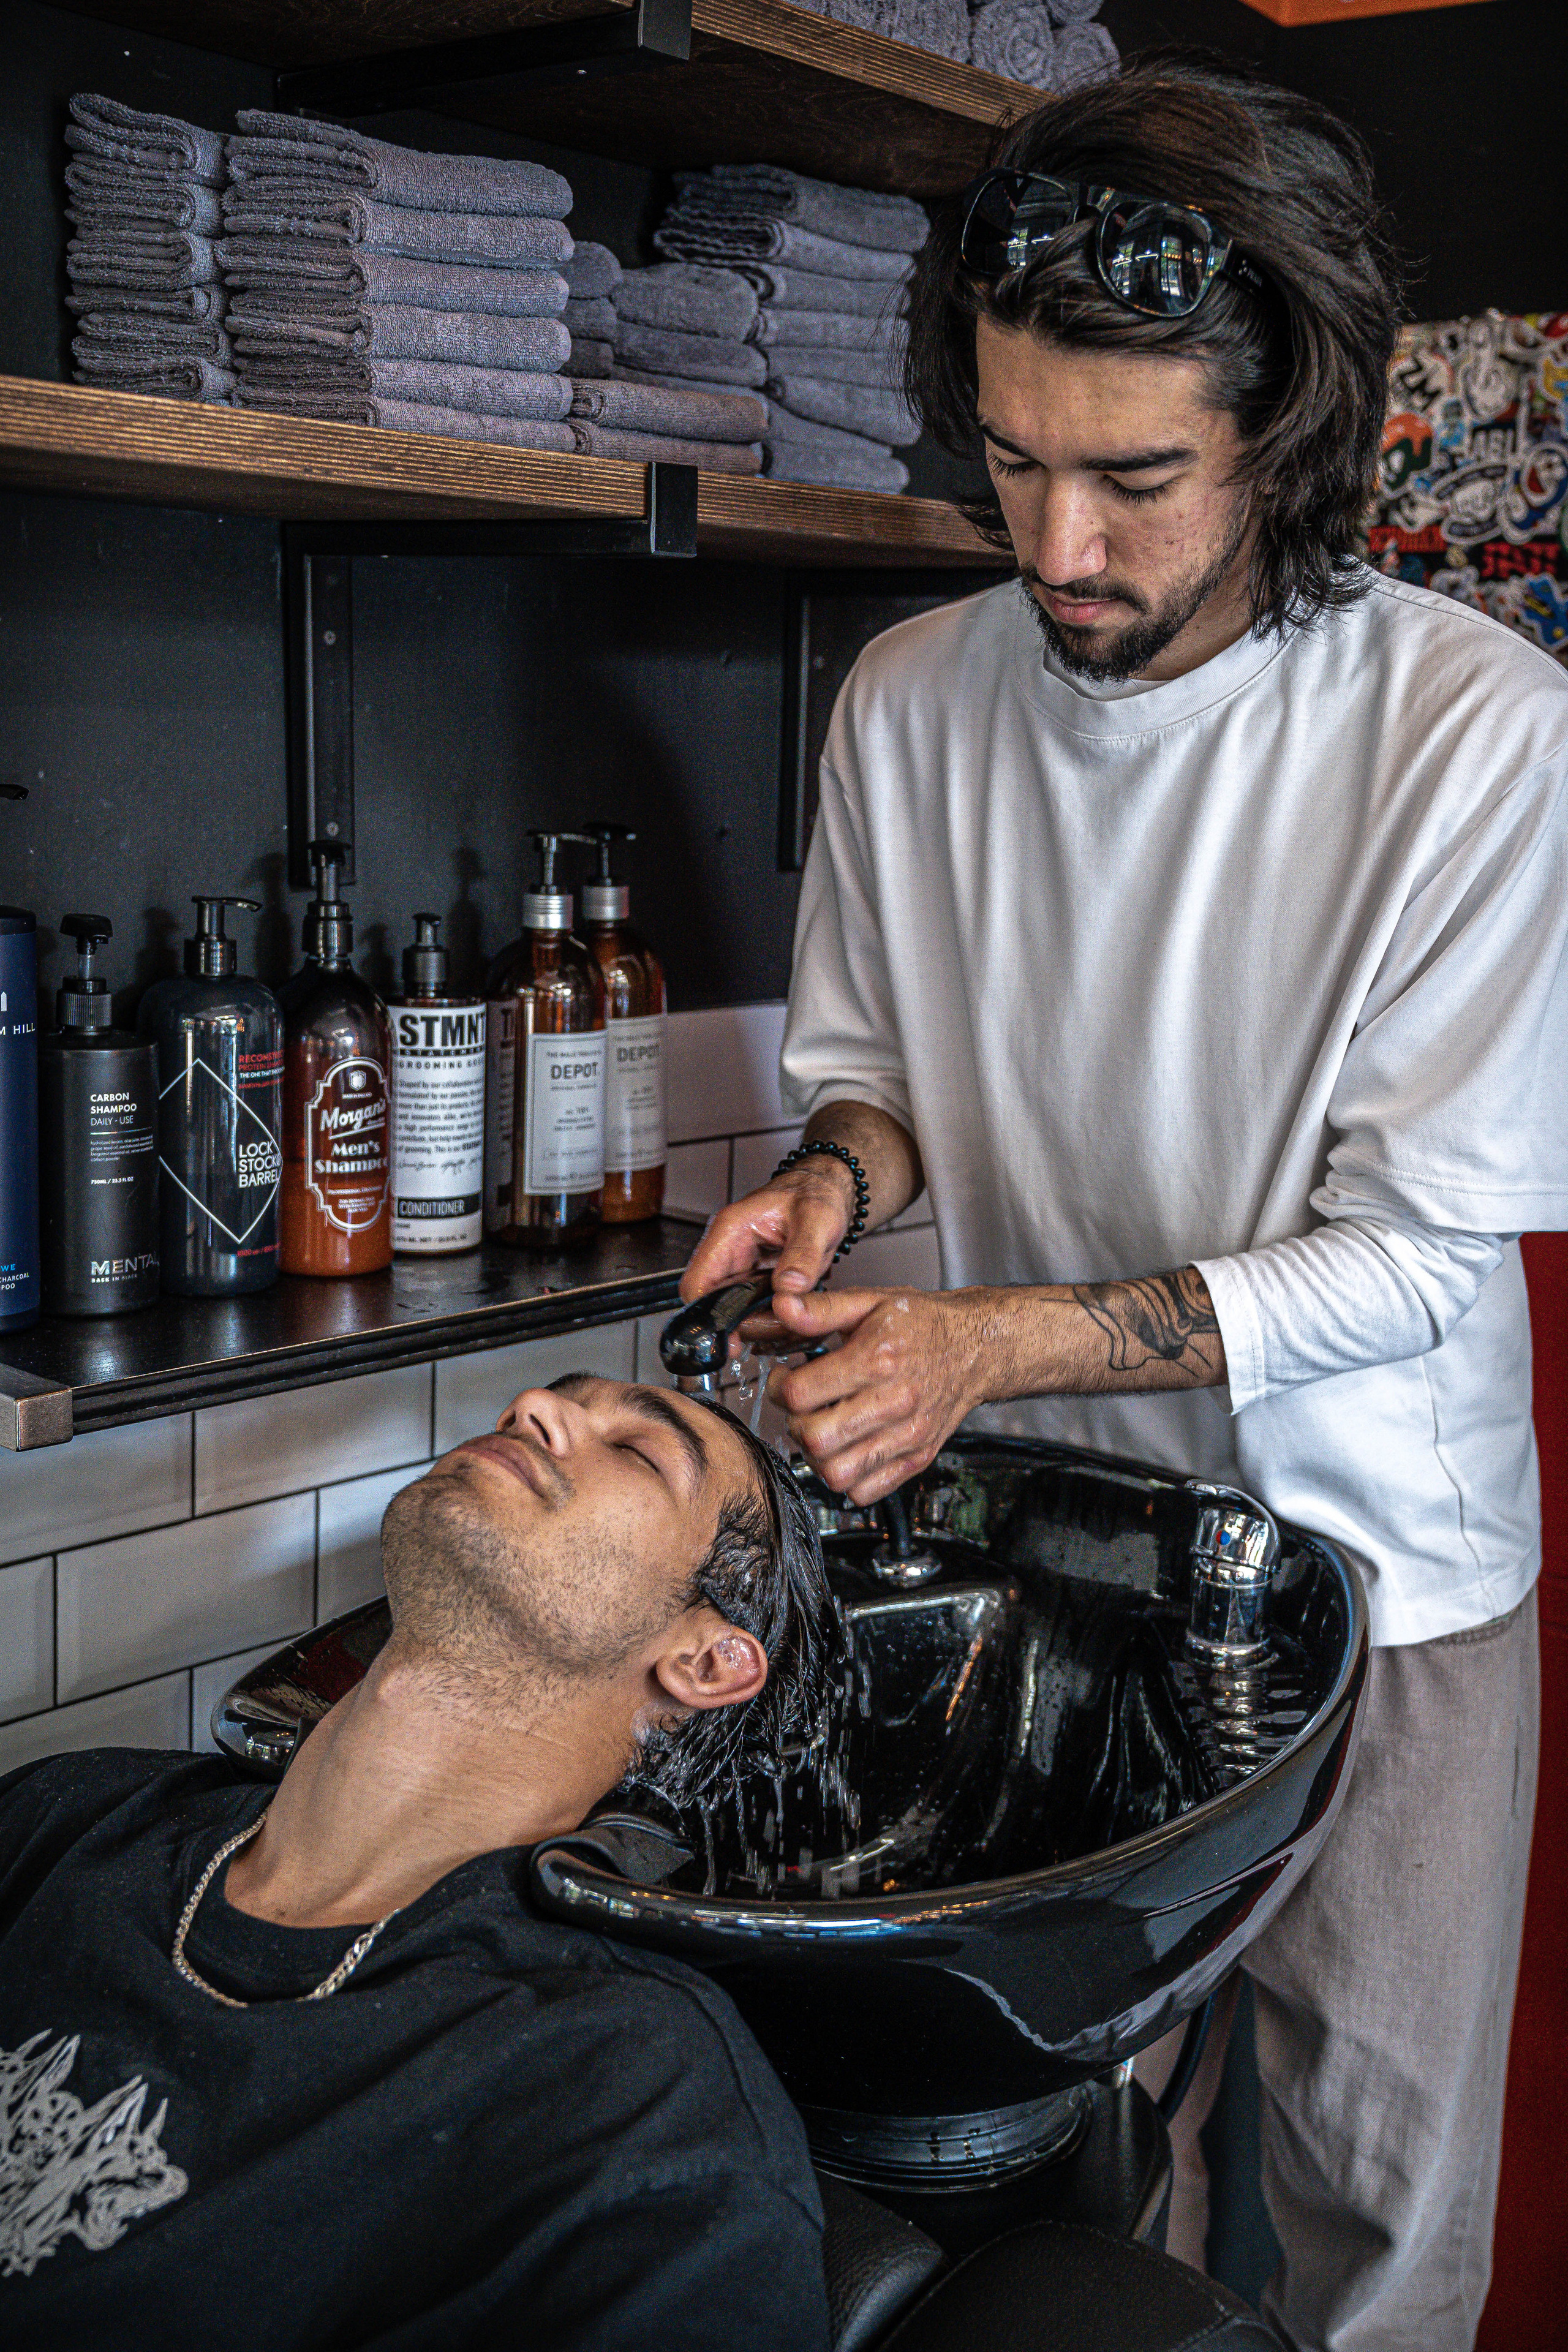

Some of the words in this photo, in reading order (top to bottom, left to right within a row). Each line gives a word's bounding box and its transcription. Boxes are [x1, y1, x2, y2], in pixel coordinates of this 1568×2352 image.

[13, 1022, 36, 1035] HILL
[399, 1060, 462, 1069] GROOMING
[551, 1062, 598, 1080] DEPOT
[91, 1092, 129, 1102] CARBON
[91, 1103, 137, 1114] SHAMPOO
[320, 1097, 386, 1131] Morgan's
[91, 1117, 113, 1126] DAILY
[119, 1115, 134, 1125] USE
[239, 1141, 273, 1158] LOCK
[331, 1140, 380, 1156] Men's
[239, 1168, 280, 1188] BARREL
[399, 1199, 464, 1216] CONDITIONER
